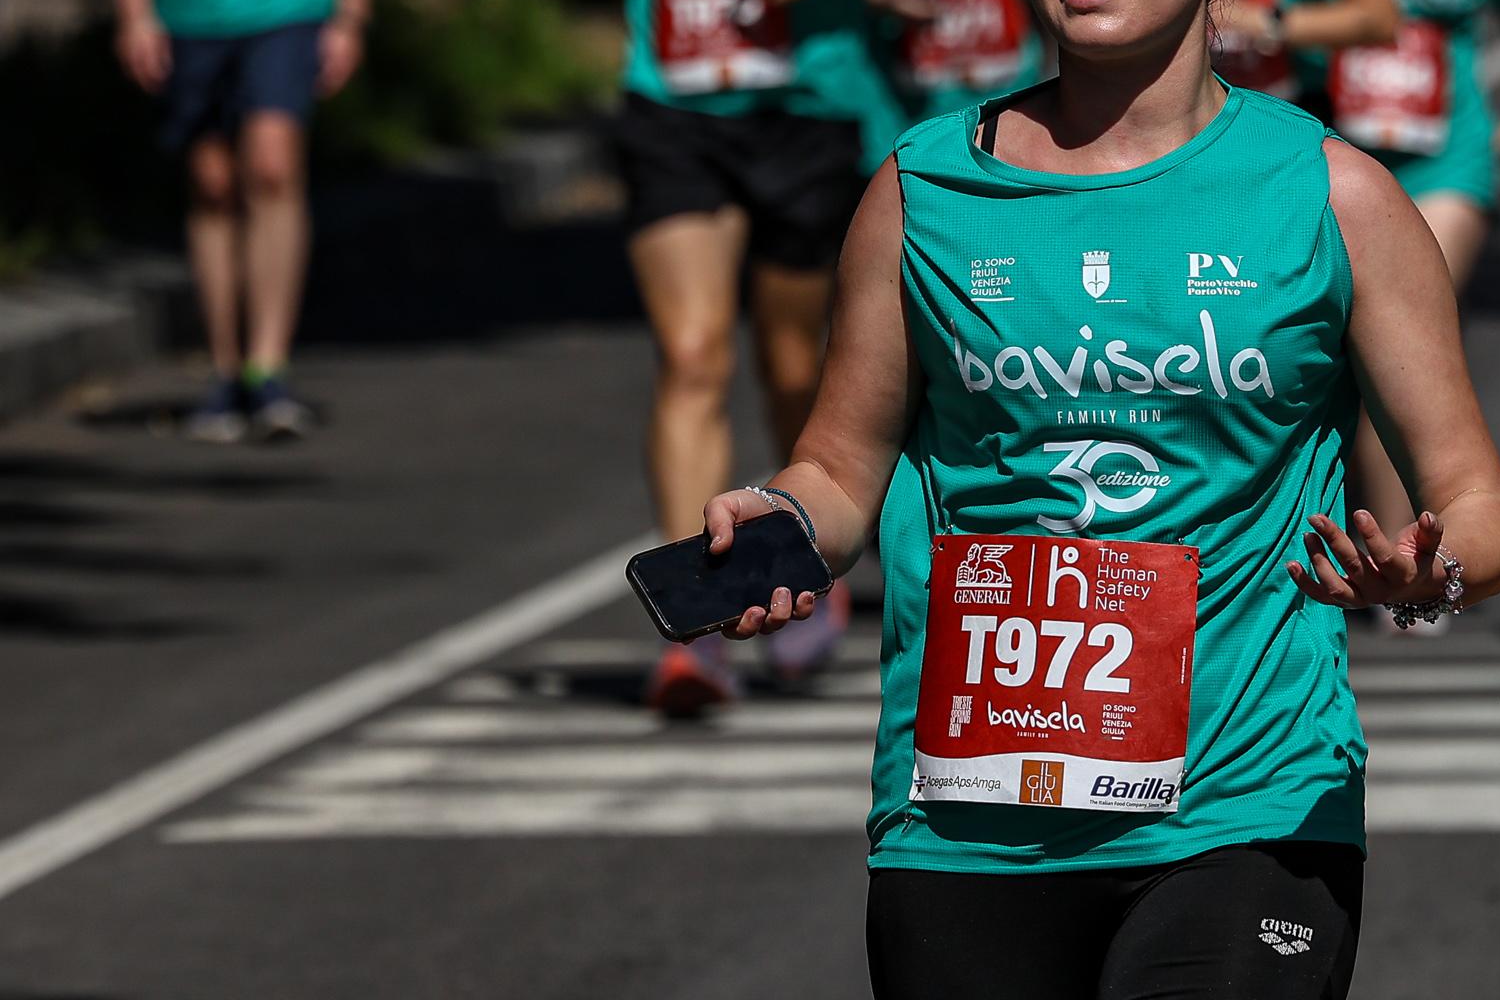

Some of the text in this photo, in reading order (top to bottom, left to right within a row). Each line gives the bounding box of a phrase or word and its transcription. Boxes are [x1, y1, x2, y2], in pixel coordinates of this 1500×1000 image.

[971, 257, 1015, 269] IO SONO
[1185, 252, 1244, 278] PV
[971, 268, 998, 278] FRIULI
[971, 276, 1011, 288] VENEZIA
[1187, 279, 1258, 288] PortoVecchio
[970, 287, 1002, 296] GIULIA
[1187, 287, 1241, 296] PortoVivo
[950, 309, 1275, 399] bavisela
[1057, 409, 1161, 424] FAMILY RUN
[1036, 439, 1160, 534] 30
[1096, 471, 1171, 487] edizione
[1098, 547, 1129, 564] The
[1097, 564, 1157, 582] Human
[954, 589, 1012, 605] GENERALI
[1095, 580, 1151, 600] Safety
[1095, 596, 1125, 612] Net
[961, 615, 1134, 693] T972
[987, 700, 1086, 733] bavisela
[1102, 712, 1123, 720] FRIULI
[1113, 705, 1137, 713] SONO
[1101, 719, 1133, 728] VENEZIA
[1101, 727, 1125, 736] GIULIA
[1090, 775, 1176, 800] Barilla
[1260, 918, 1314, 941] arena
